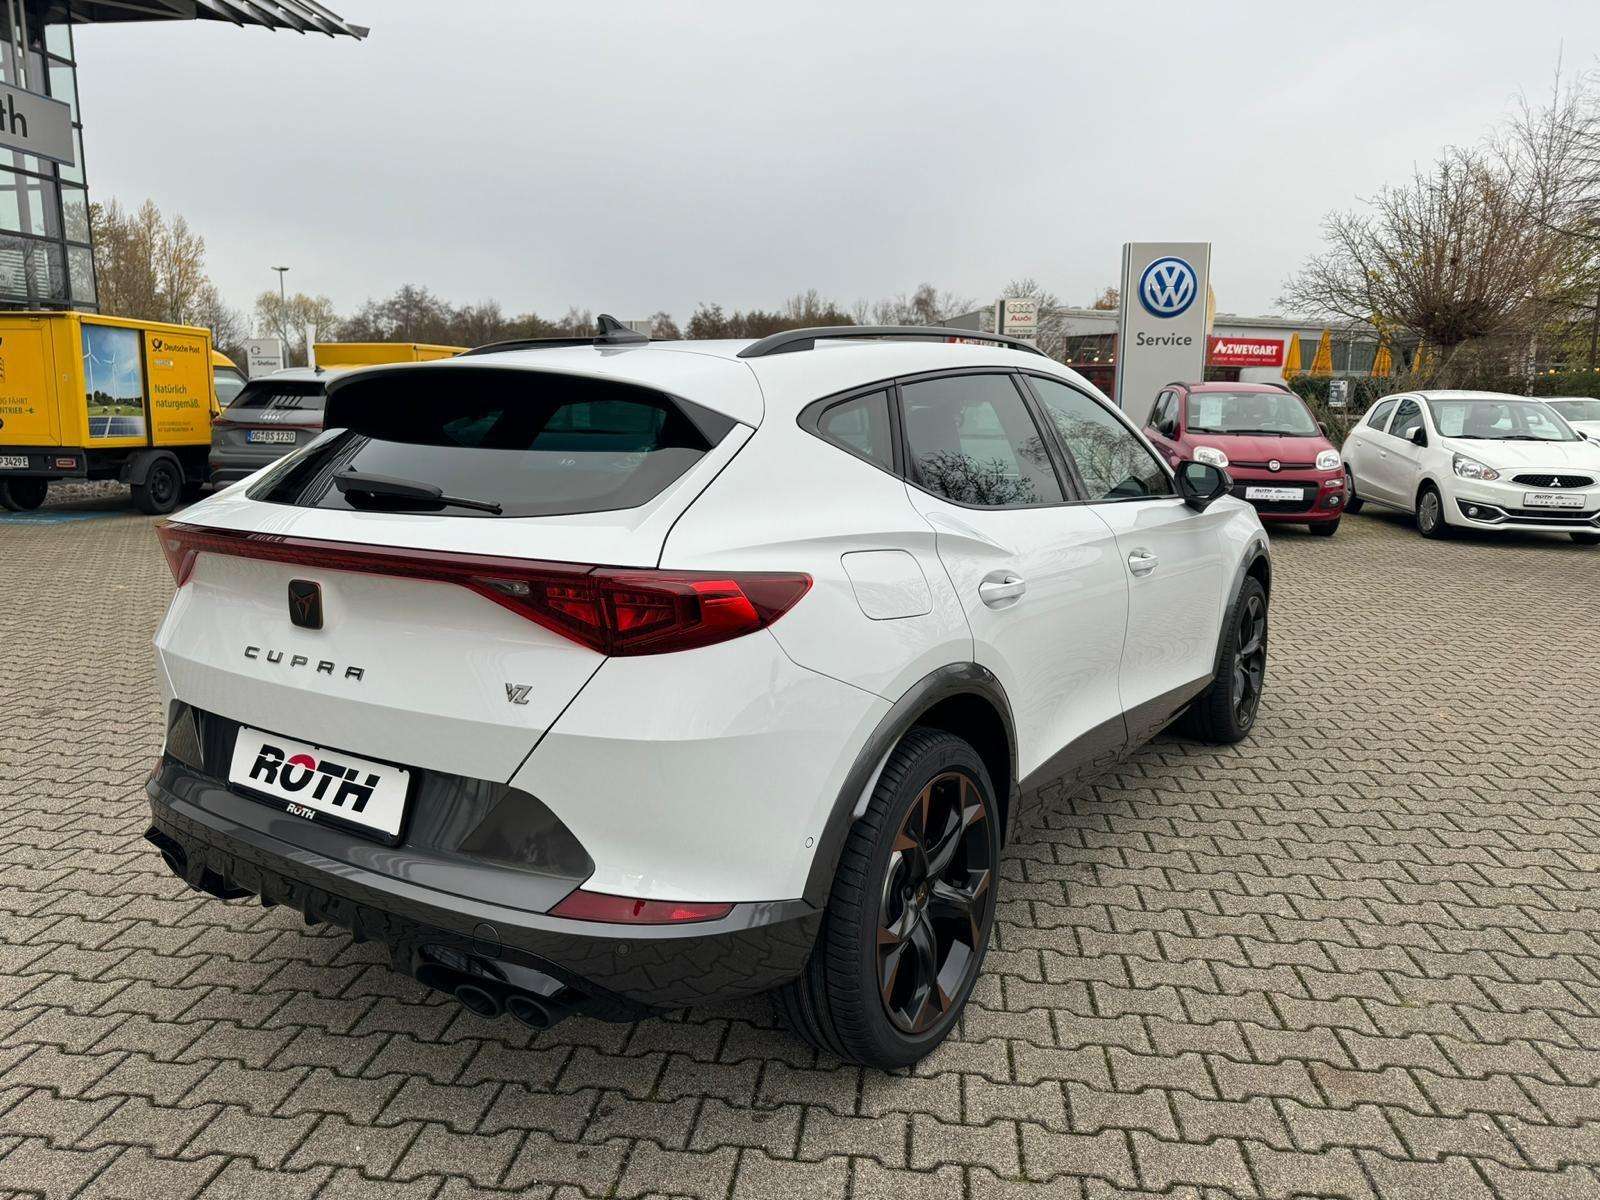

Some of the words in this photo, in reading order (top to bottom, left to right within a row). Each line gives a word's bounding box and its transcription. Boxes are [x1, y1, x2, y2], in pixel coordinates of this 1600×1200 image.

[1136, 332, 1193, 346] Service
[163, 343, 189, 352] Deutsche
[189, 345, 200, 354] Post
[154, 383, 187, 394] Natürlich
[155, 398, 200, 411] naturgemäß.
[244, 645, 365, 681] CUPRA
[505, 683, 533, 705] VZ
[249, 744, 381, 813] ROTH
[286, 803, 315, 820] ROTH
